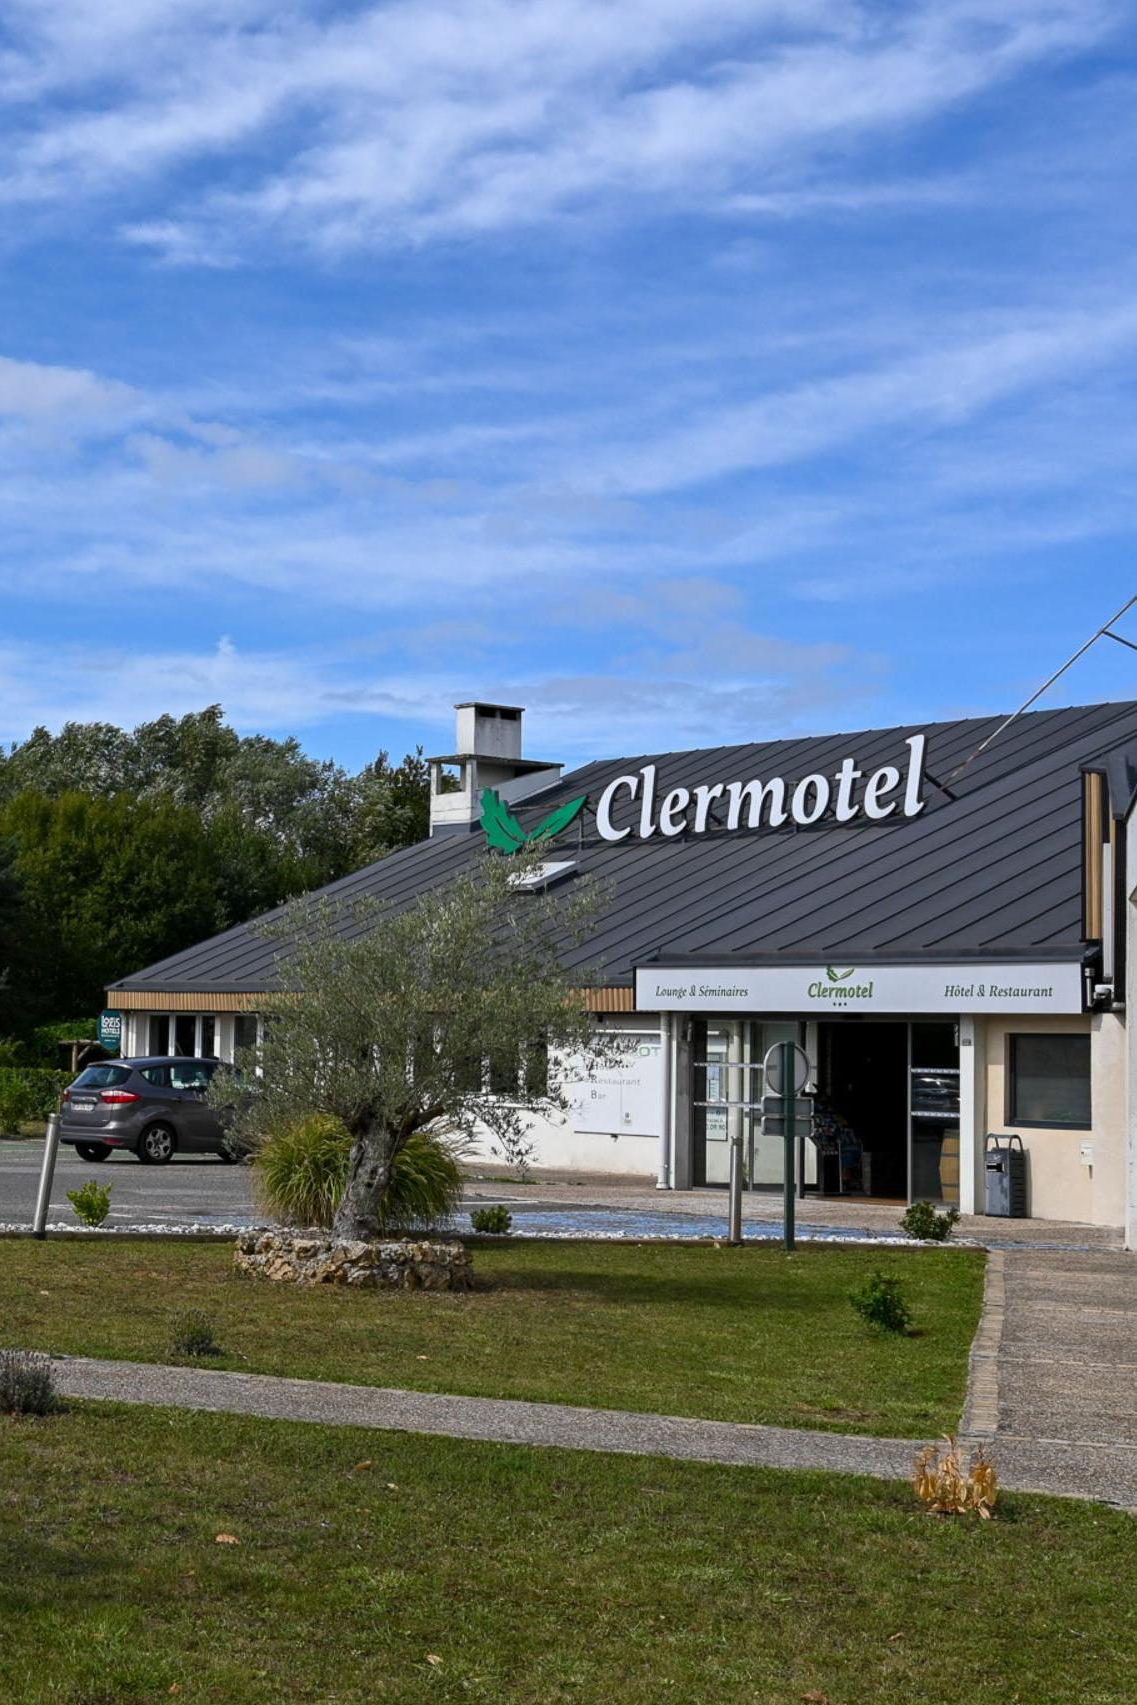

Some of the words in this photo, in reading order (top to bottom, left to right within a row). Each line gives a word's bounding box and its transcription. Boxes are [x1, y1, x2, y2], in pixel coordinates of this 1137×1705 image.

[596, 734, 925, 841] Clermotel
[655, 985, 687, 999] Lounge
[688, 985, 696, 997] &
[699, 985, 748, 998] Séminaires
[807, 981, 873, 999] Clermotel
[944, 984, 974, 997] Hôtel
[976, 984, 985, 997] &
[989, 984, 1053, 997] Restaurant
